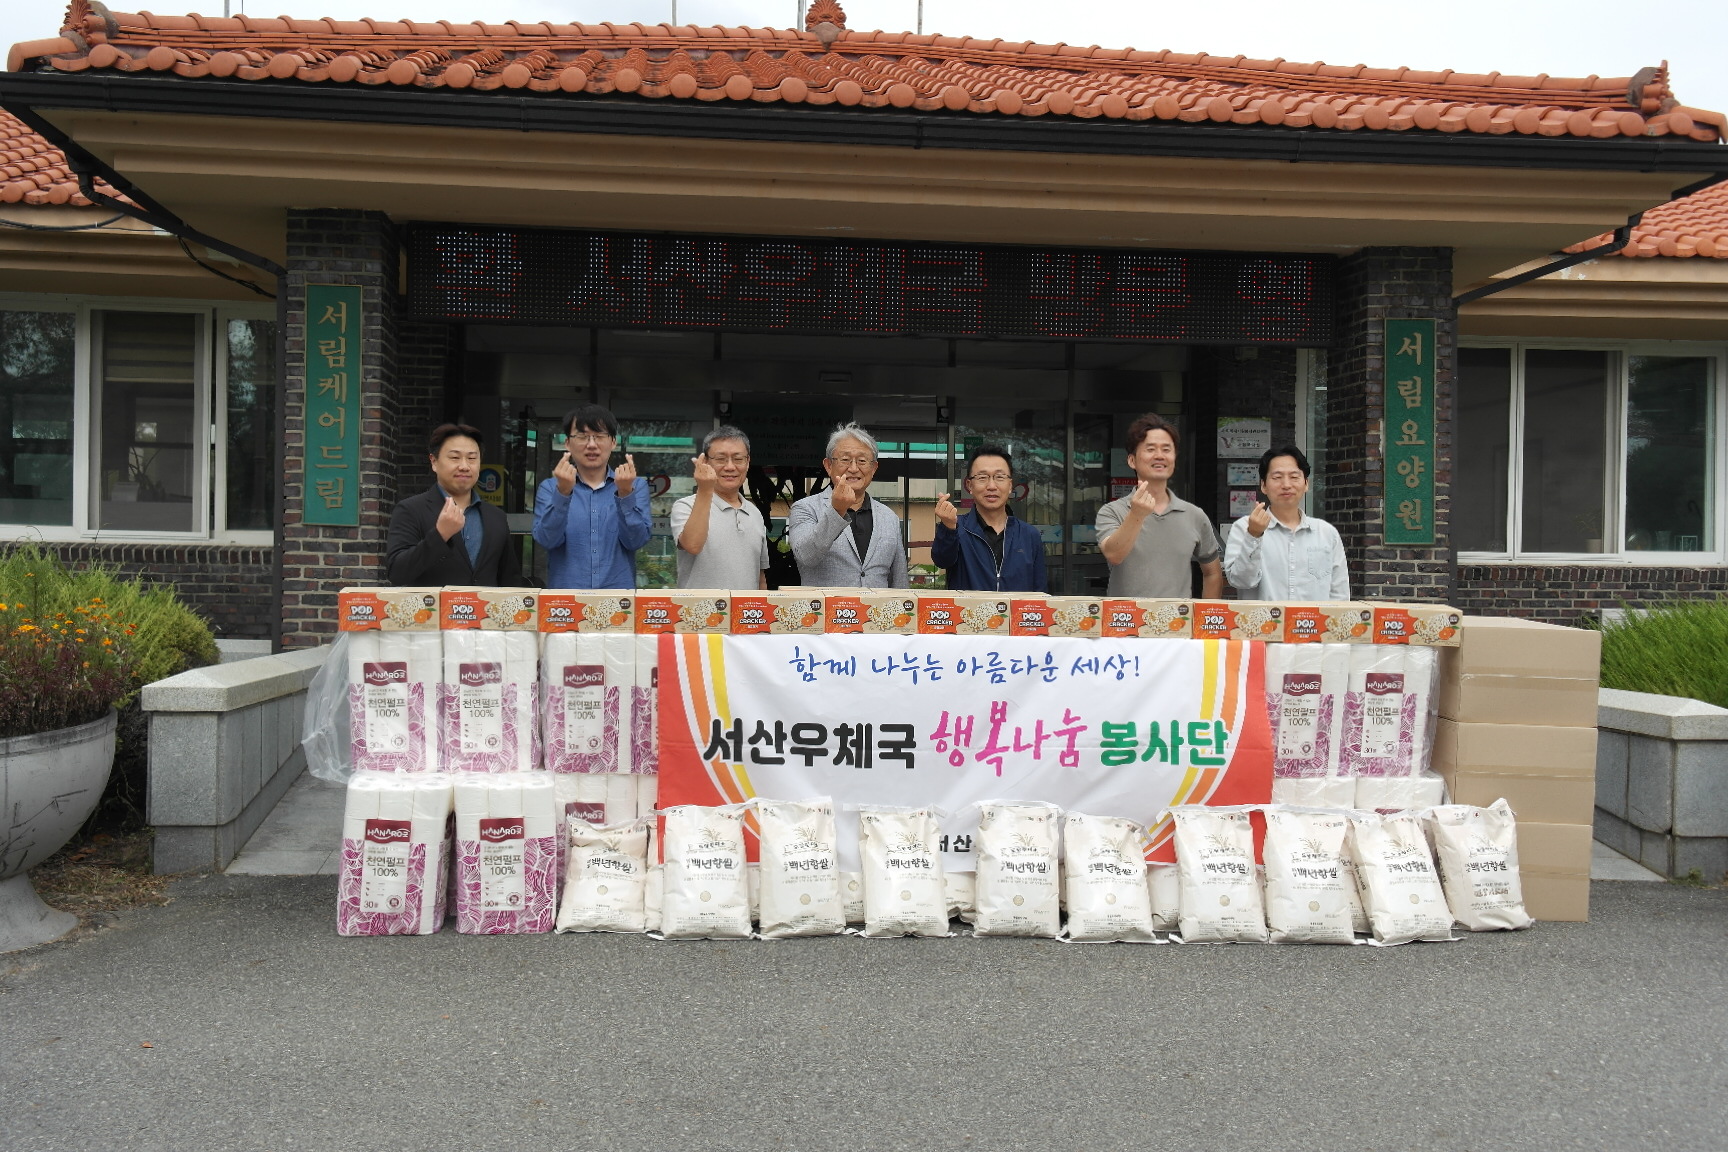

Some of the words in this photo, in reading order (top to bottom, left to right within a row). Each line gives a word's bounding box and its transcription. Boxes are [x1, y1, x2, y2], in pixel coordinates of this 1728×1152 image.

[566, 236, 987, 334] 서산우체국
[1029, 253, 1191, 339] 방문
[315, 301, 348, 509] 서림케어드림
[1395, 332, 1426, 530] 서림요양원
[351, 605, 374, 615] POP
[452, 604, 474, 614] POP
[550, 608, 572, 616] POP
[646, 609, 668, 618] POP
[742, 609, 764, 618] POP
[836, 609, 857, 618] POP
[930, 611, 950, 620] POP
[1022, 612, 1042, 621] POP
[1112, 612, 1133, 622] POP
[1204, 616, 1225, 624] POP
[1296, 620, 1316, 628] POP
[1384, 621, 1404, 630] POP
[789, 646, 857, 684] 함께
[871, 650, 942, 684] 나누는
[956, 651, 1058, 683] 아름다운
[1070, 653, 1141, 682] 세상!
[368, 698, 406, 708] 천연펄프
[462, 698, 500, 709] 천연펄프
[567, 700, 602, 710] 천연펄프
[375, 709, 400, 718] 100%
[469, 709, 494, 718] 100%
[574, 711, 595, 720] 100%
[1283, 707, 1317, 717] 천연펄프
[1366, 706, 1400, 716] 천연펄프
[1288, 718, 1311, 726] 100%
[1371, 717, 1394, 726] 100%
[703, 717, 917, 770] 서산우체국
[929, 701, 1088, 777] 행복나눔
[1099, 719, 1229, 767] 봉사단
[366, 856, 406, 868] 천연펄프
[483, 854, 522, 866] 천연펄프
[372, 868, 398, 877] 100%
[490, 866, 516, 876] 100%
